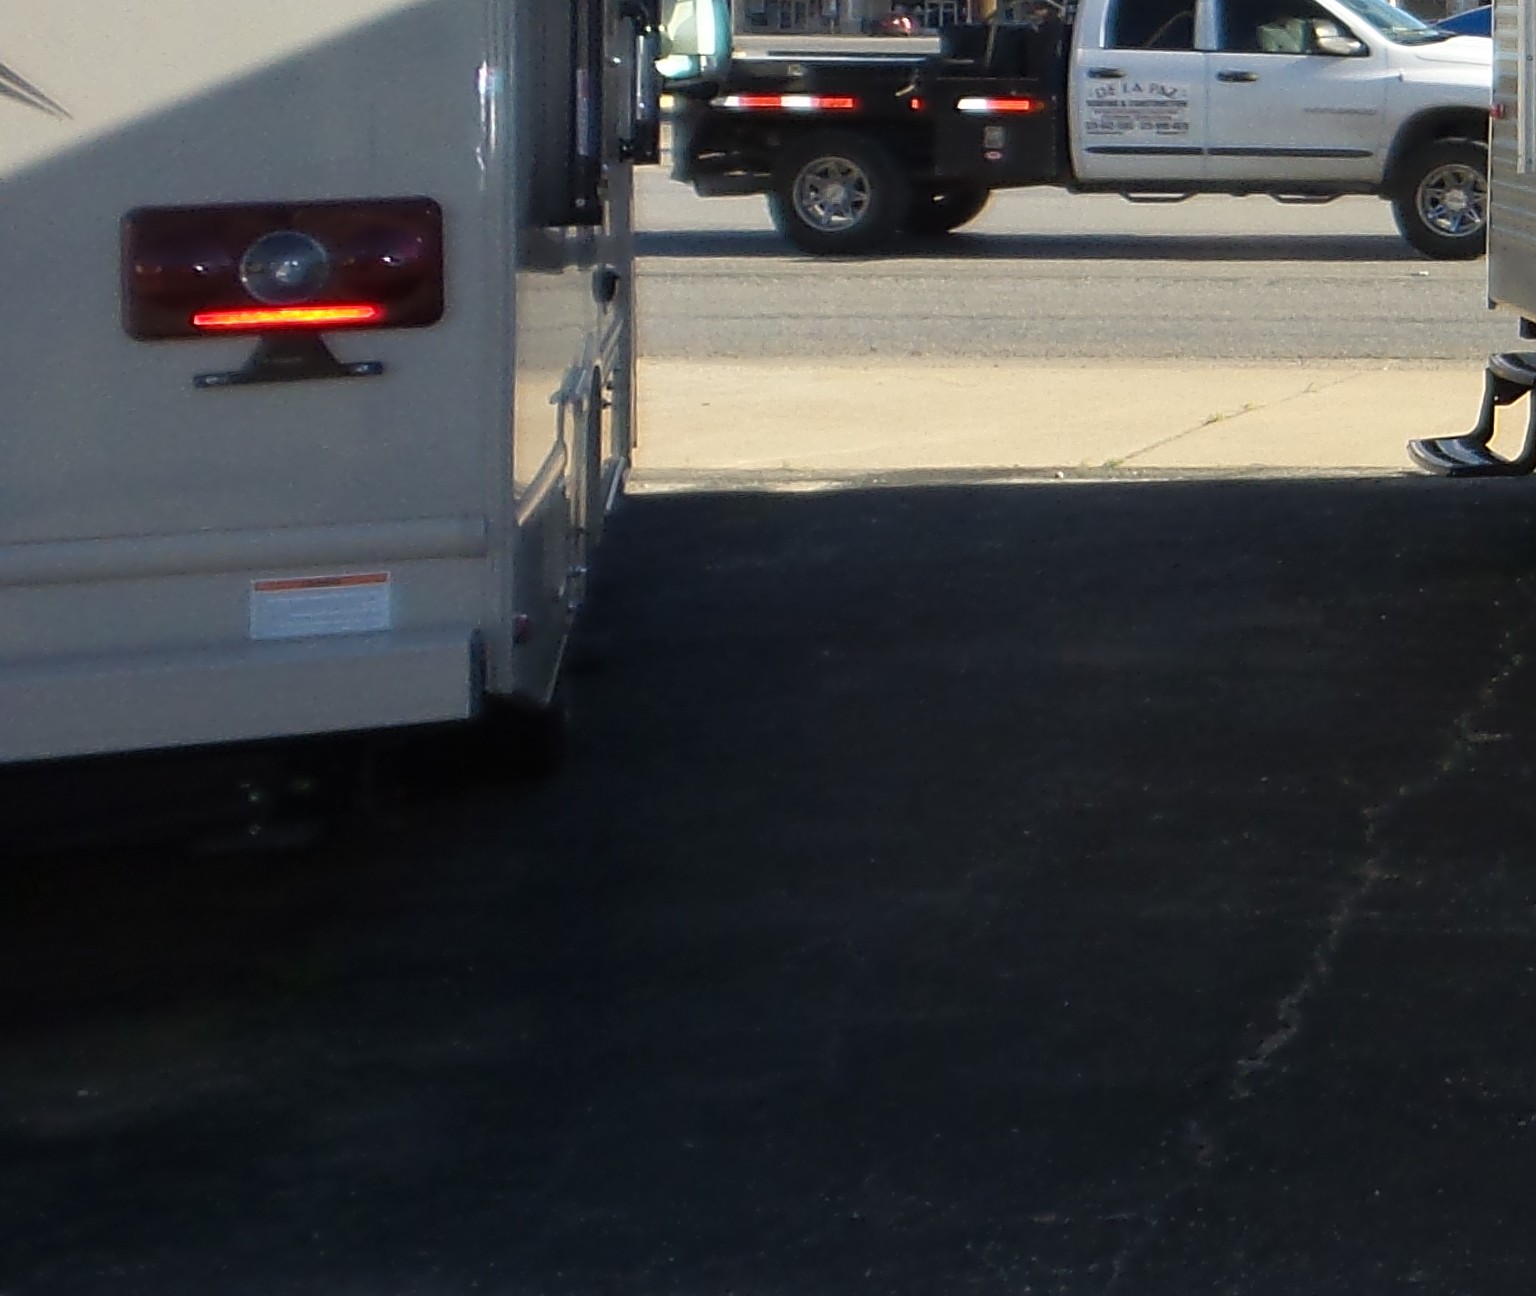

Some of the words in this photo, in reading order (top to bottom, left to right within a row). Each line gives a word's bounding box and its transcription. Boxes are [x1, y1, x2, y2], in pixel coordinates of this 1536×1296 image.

[1094, 84, 1115, 99] DE
[1122, 82, 1143, 93] LA
[1149, 82, 1178, 99] PAZ
